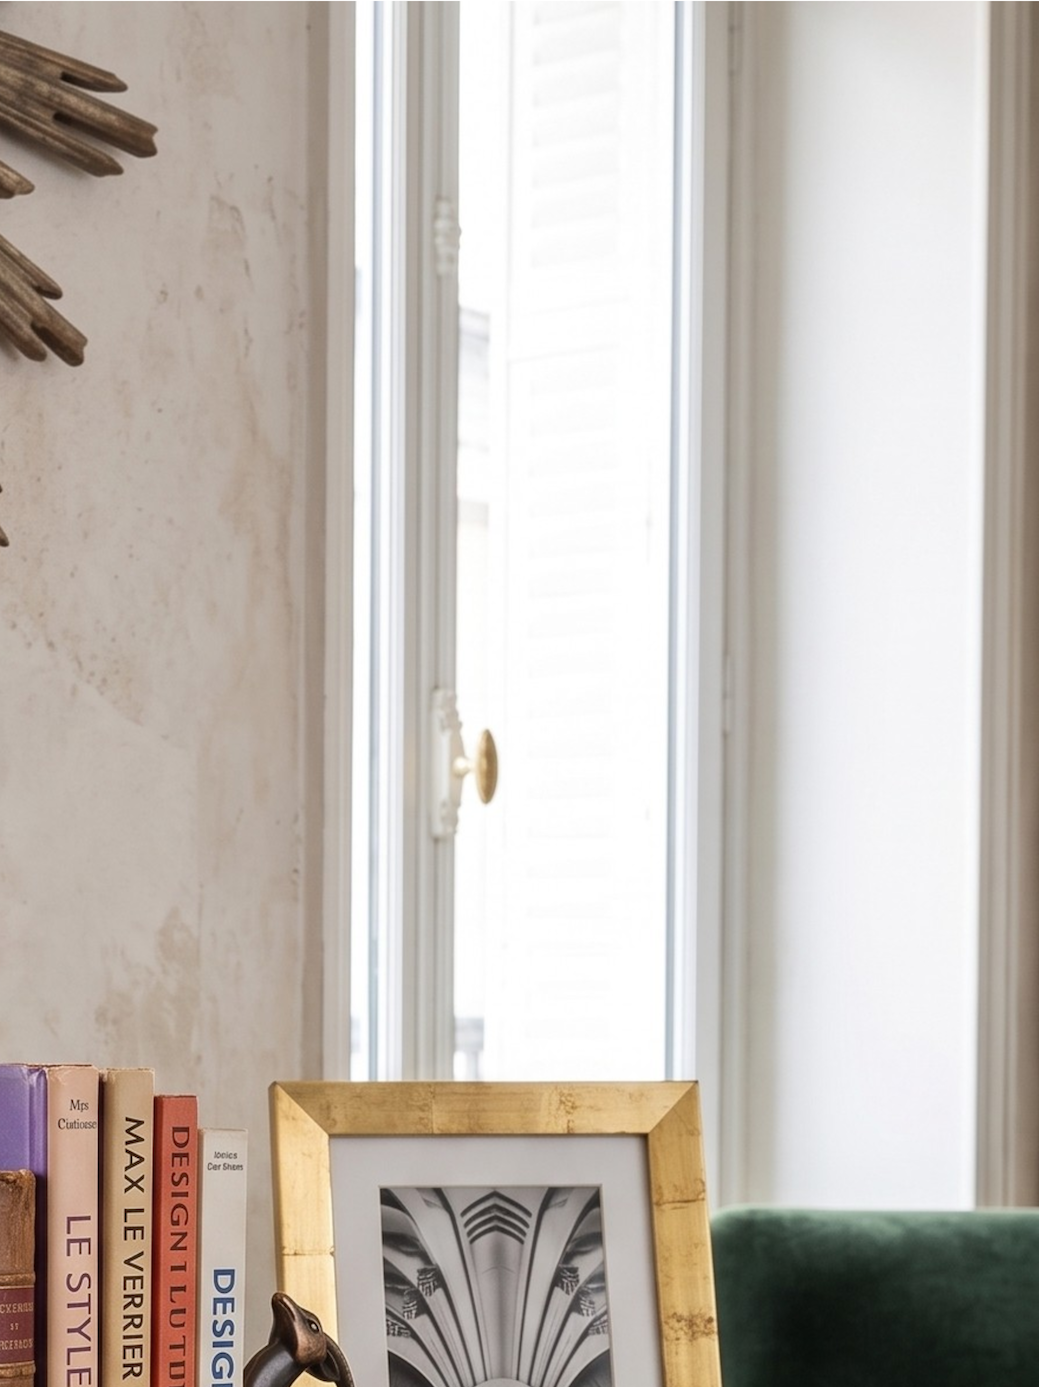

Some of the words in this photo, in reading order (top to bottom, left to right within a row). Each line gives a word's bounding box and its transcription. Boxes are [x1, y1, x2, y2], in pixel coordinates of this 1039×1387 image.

[124, 1116, 145, 1194] MAX
[170, 1126, 190, 1251] DESIGN
[66, 1215, 92, 1257] LE
[124, 1208, 145, 1241] LE
[66, 1272, 92, 1387] STYLE
[122, 1251, 144, 1381] VERRIER
